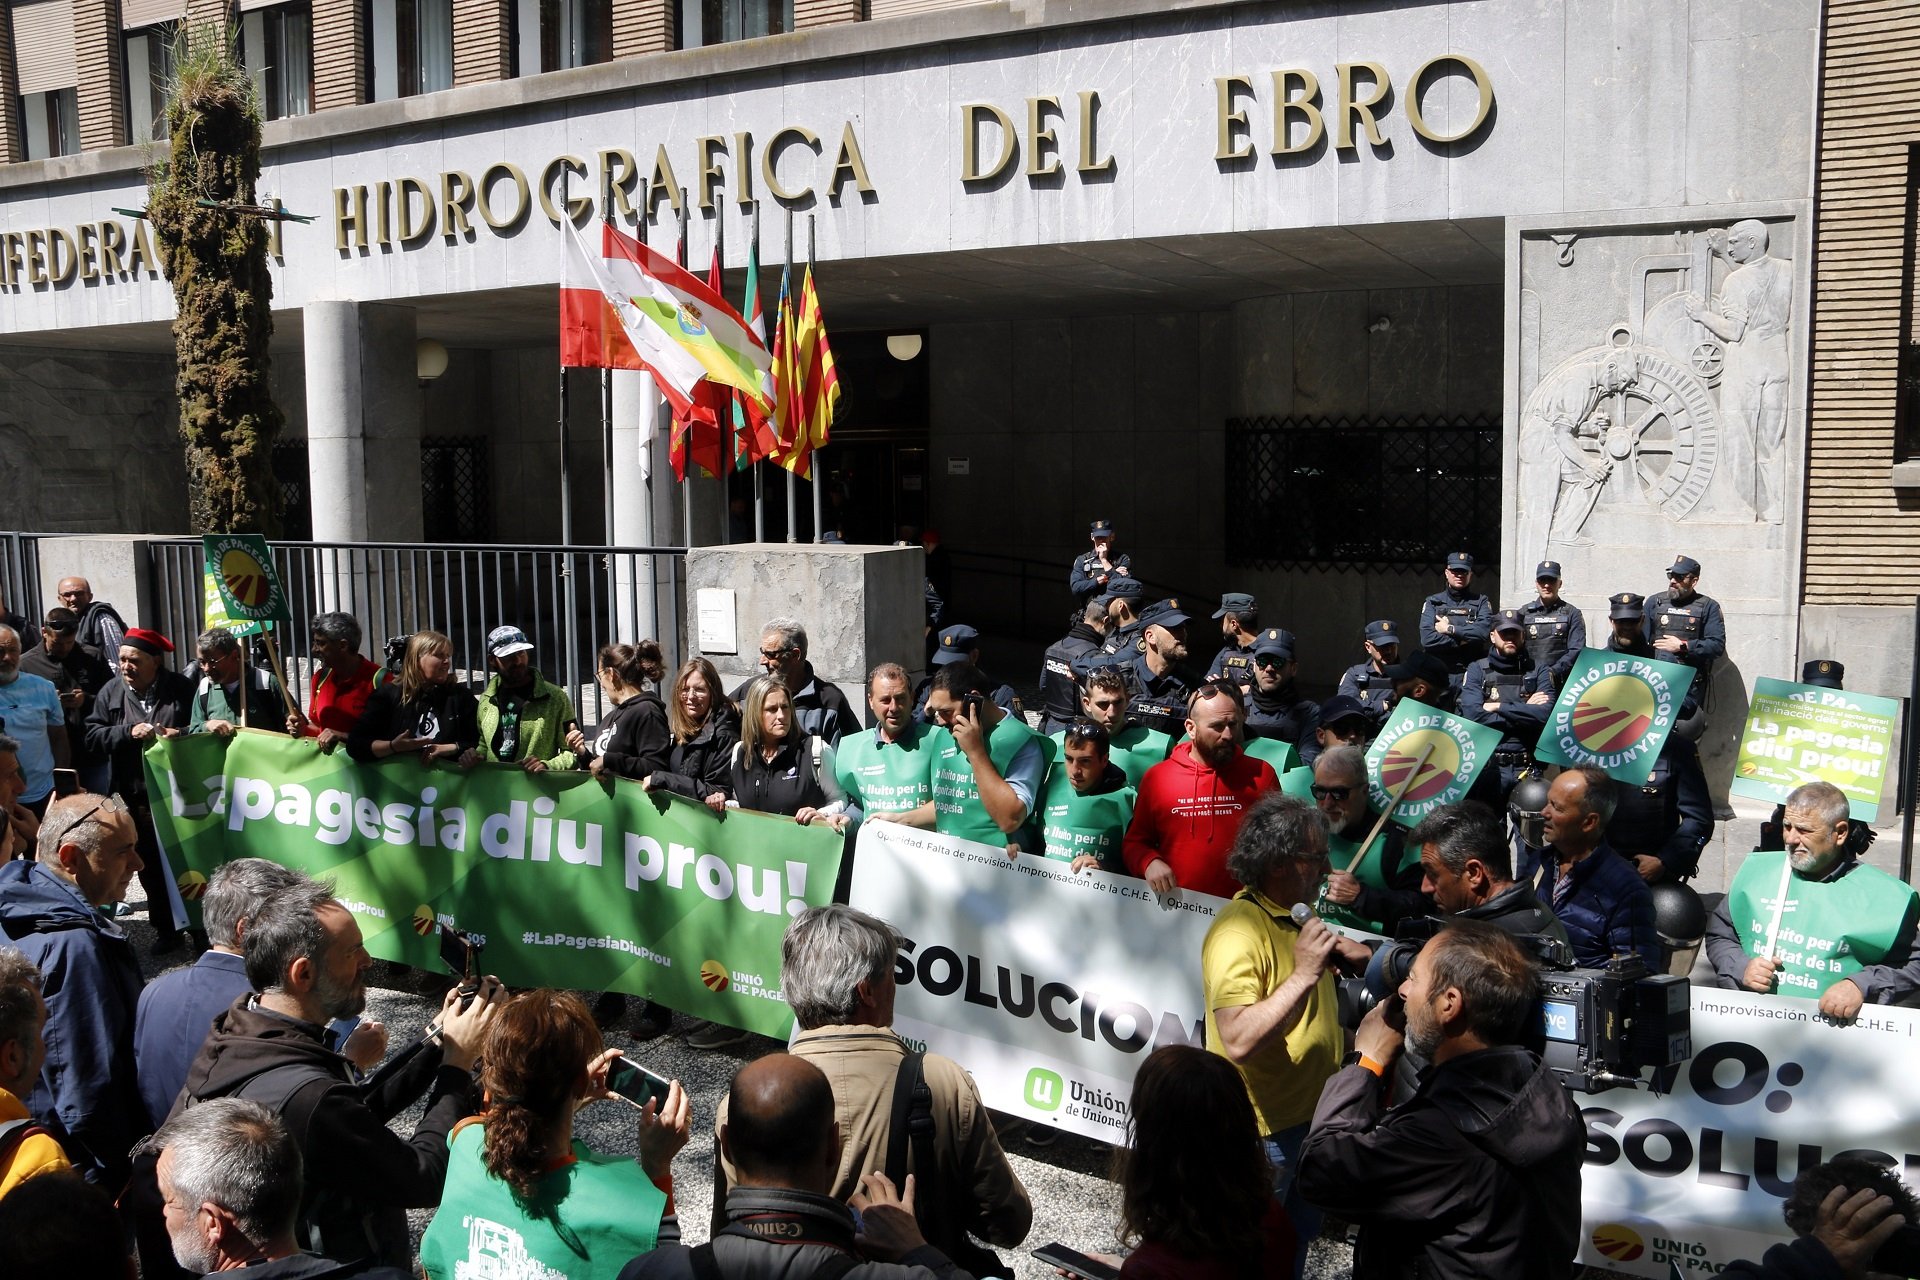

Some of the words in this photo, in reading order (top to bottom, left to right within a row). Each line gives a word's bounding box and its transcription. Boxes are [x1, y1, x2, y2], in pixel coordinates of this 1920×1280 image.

[333, 121, 875, 250] HIDROGRAFICA
[960, 91, 1114, 181] DEL
[1214, 54, 1496, 161] EBRO
[1562, 666, 1600, 708] UNIÓ
[1604, 660, 1628, 676] DE
[1630, 660, 1672, 728] PAGESOS
[1556, 712, 1570, 736] DE
[1773, 704, 1813, 720] inacció
[1815, 712, 1839, 724] dels
[1840, 720, 1888, 734] governs
[1374, 717, 1414, 752] UNIÓ
[1418, 714, 1442, 728] DE
[1442, 717, 1476, 784] PAGESOS
[1750, 717, 1780, 736] La
[1784, 725, 1884, 756] pagesia
[1559, 731, 1662, 770] CATALUNYA
[1746, 737, 1794, 762] diu
[1800, 750, 1882, 778] prou!
[867, 784, 894, 796] lluito
[896, 785, 915, 798] per
[918, 782, 928, 793] la
[956, 773, 968, 784] per
[898, 798, 914, 810] de
[956, 786, 966, 798] de
[968, 788, 979, 800] la
[1368, 780, 1461, 816] CATLUNYA
[168, 770, 226, 817] La
[228, 776, 466, 852] pagesia
[480, 796, 602, 867] diu
[624, 831, 808, 918] prou!
[1052, 826, 1072, 840] lluito
[1074, 834, 1096, 845] per
[1098, 834, 1110, 846] la
[926, 842, 951, 856] Falta
[952, 848, 966, 859] de
[967, 853, 1015, 871] previsión.
[1017, 863, 1090, 888] Improvisación
[1092, 880, 1106, 892] de
[1108, 883, 1118, 894] la
[1121, 888, 1152, 902] C.H.E.
[1167, 898, 1216, 916] Opacitat.
[522, 931, 672, 968] #LaPagesiaDiuProu
[1806, 936, 1835, 951] per
[1837, 940, 1850, 952] la
[1806, 954, 1826, 971] de
[1829, 959, 1842, 973] la
[732, 971, 763, 986] UNIÓ
[732, 982, 749, 995] DE
[752, 986, 788, 1002] PAGE
[1775, 970, 1818, 990] gesia
[894, 937, 1205, 1054] SOLUCION
[1700, 1000, 1807, 1022] Improvisación
[1855, 1017, 1899, 1033] C.H.E.
[1066, 1102, 1080, 1117] de
[1070, 1080, 1128, 1115] Unión
[1652, 1237, 1707, 1257] UNIÓ
[1686, 1258, 1727, 1274] PAG
